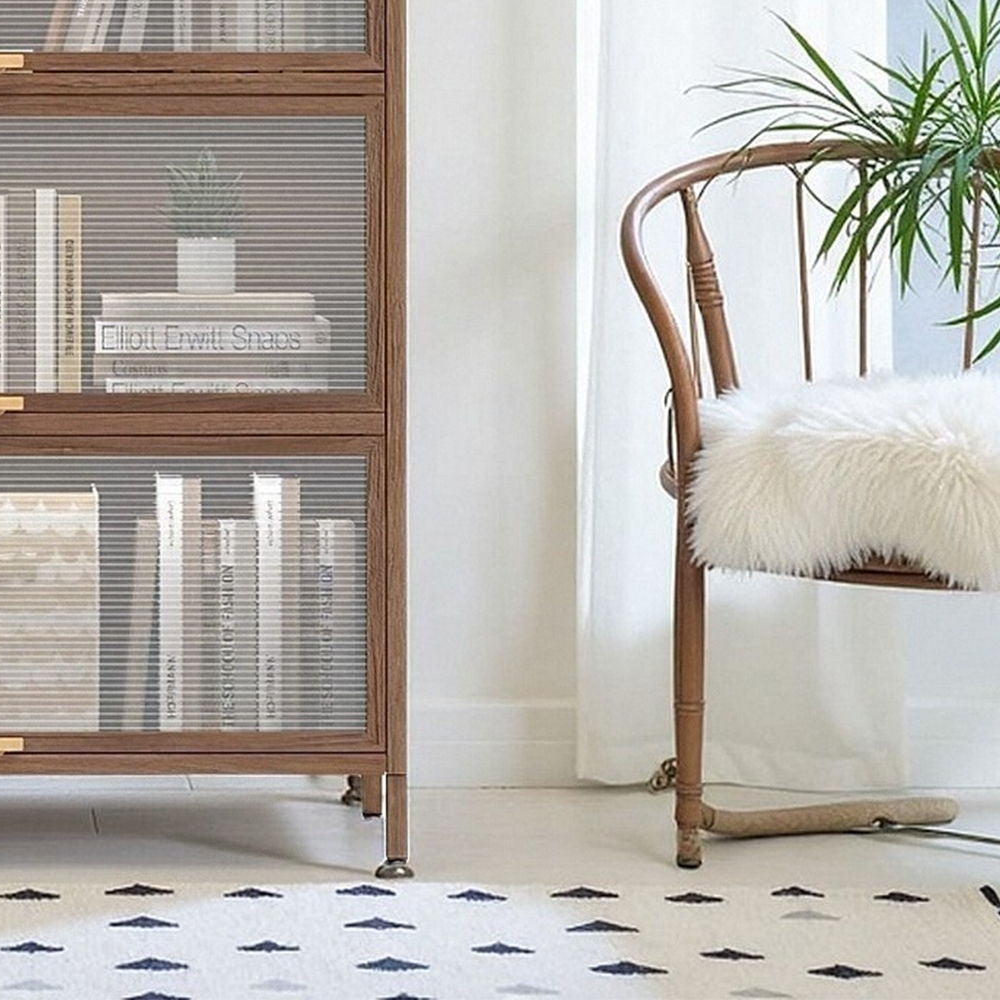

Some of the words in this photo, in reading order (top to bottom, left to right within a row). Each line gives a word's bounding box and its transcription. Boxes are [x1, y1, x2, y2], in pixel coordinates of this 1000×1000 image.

[101, 324, 157, 350] Elliott
[164, 324, 225, 350] Erwitt
[112, 360, 168, 377] Cosmos
